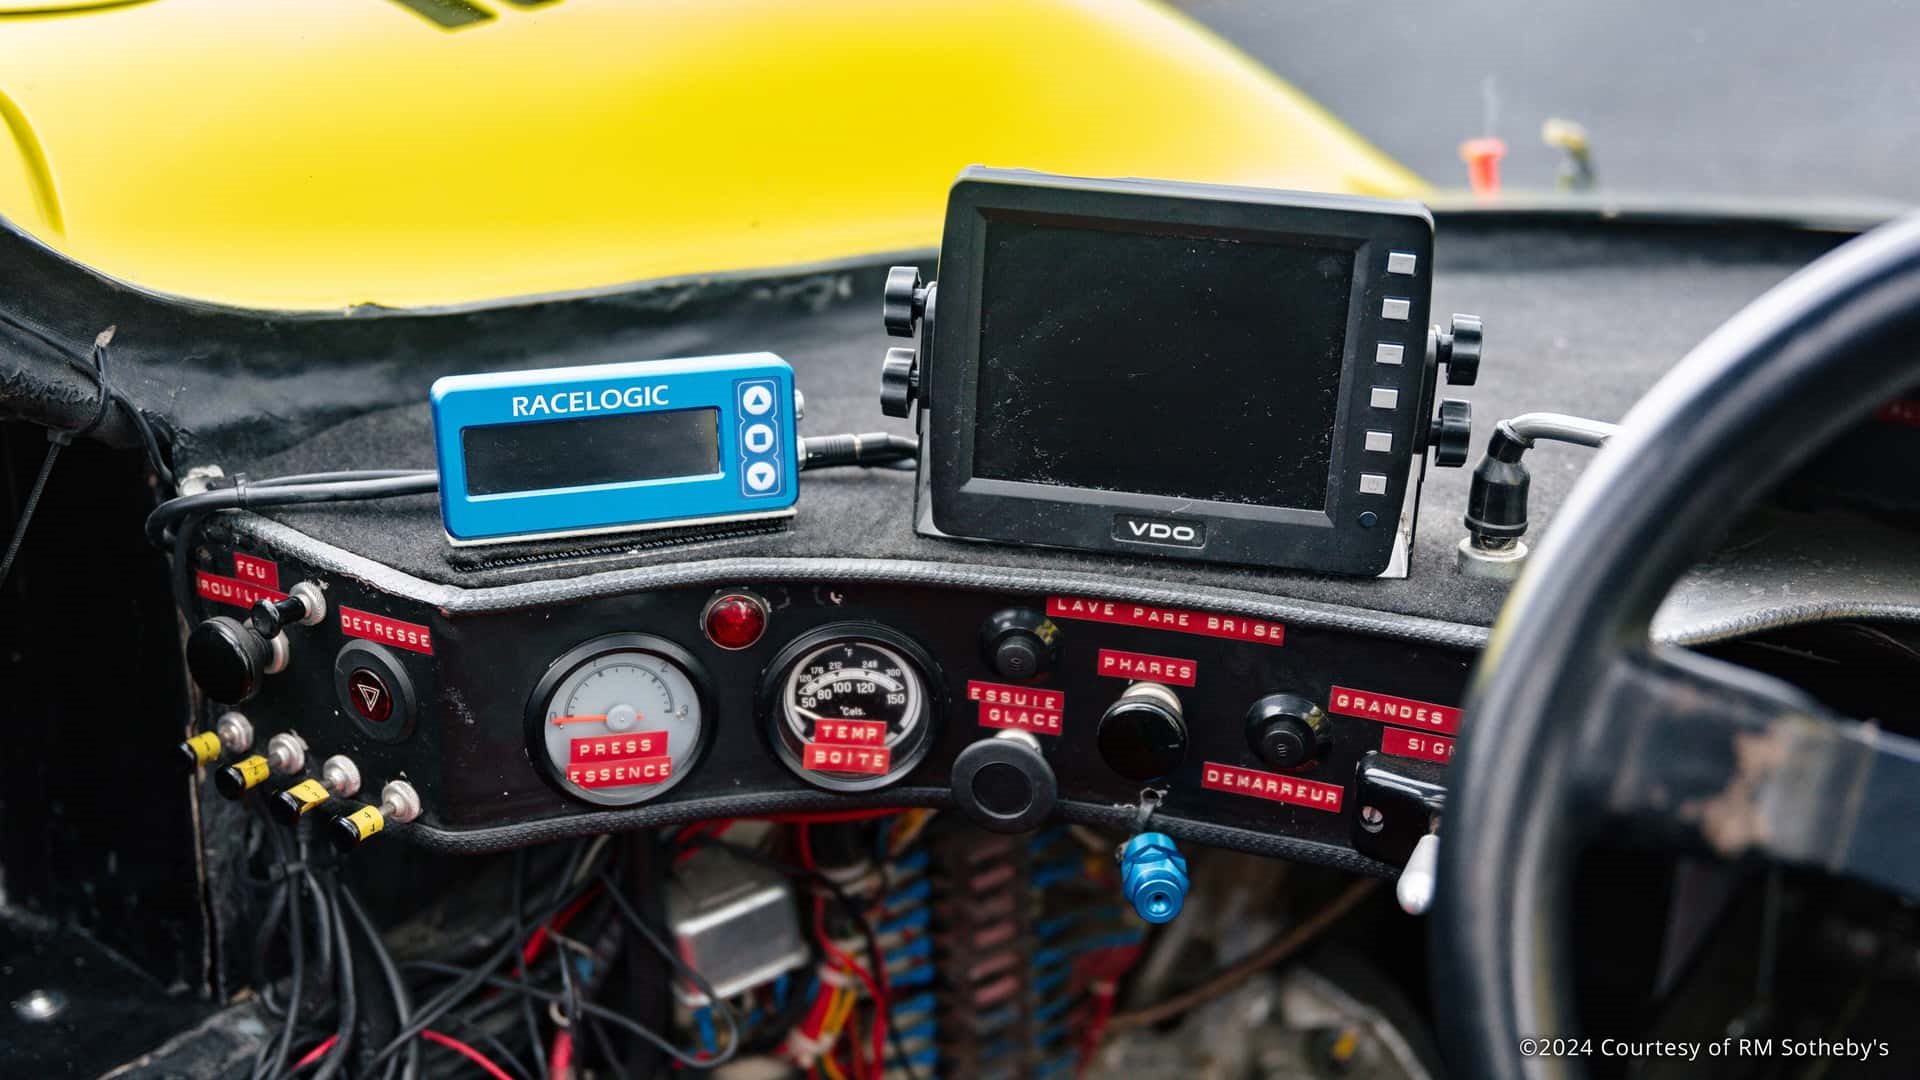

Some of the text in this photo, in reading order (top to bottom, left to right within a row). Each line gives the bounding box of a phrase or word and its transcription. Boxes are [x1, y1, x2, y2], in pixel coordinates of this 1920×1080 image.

[512, 385, 669, 417] RACELOGIC
[1128, 520, 1195, 541] VDO
[236, 560, 265, 579] FEU
[1057, 599, 1281, 640] LAVE PARE BRISE
[340, 613, 430, 648] DETRESSE
[828, 661, 843, 670] 212
[1104, 656, 1192, 679] PHARES
[801, 682, 905, 708] 50 80 100 120 150
[971, 687, 1056, 709] ESSUIE
[989, 708, 1059, 728] GLACE
[1336, 694, 1443, 725] GRANDES
[821, 725, 878, 740] TEMP
[579, 739, 652, 757] PRESS
[814, 751, 885, 768] BOITE
[570, 763, 670, 784] ESSENCE
[1207, 769, 1338, 804] DEMARREUR
